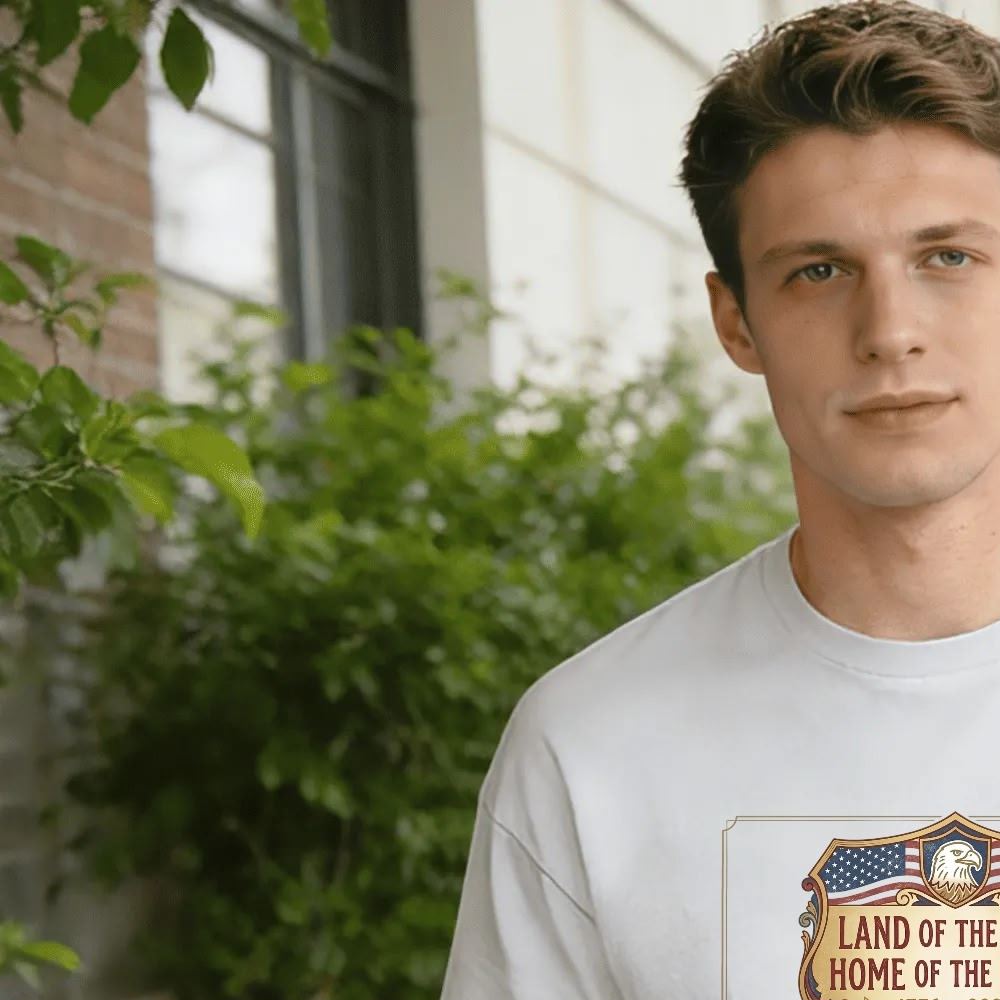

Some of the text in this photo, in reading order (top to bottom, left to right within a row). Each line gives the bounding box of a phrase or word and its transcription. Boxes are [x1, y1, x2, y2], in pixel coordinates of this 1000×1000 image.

[838, 915, 910, 950] LAND
[919, 918, 946, 948] OF
[955, 919, 998, 948] THE
[829, 957, 906, 991] HOME
[914, 959, 942, 988] OF
[949, 959, 992, 988] THE
